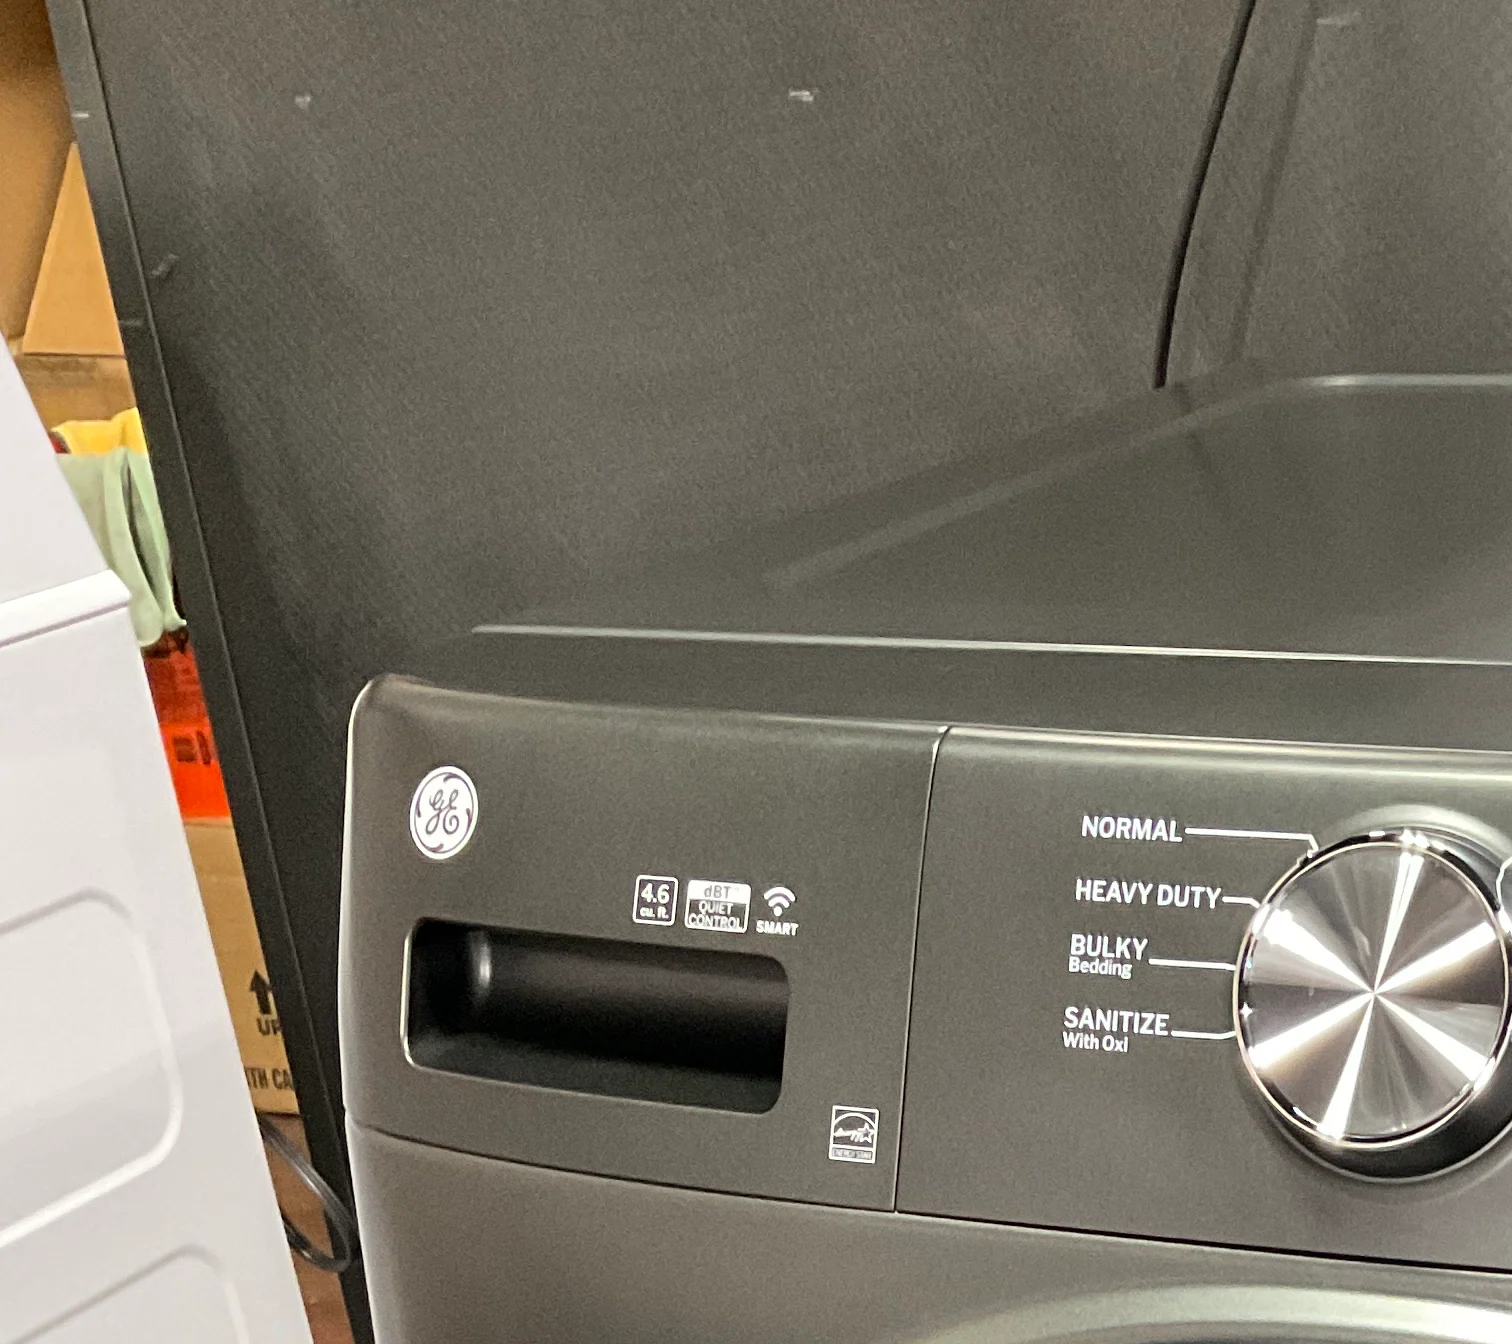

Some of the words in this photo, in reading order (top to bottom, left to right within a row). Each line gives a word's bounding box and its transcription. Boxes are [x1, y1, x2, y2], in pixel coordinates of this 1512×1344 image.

[1081, 815, 1183, 843] NORMAL
[641, 882, 670, 904] 4.6
[1075, 878, 1153, 905] HEAVY
[1156, 883, 1222, 909] DUTY
[698, 901, 734, 915] QUIET
[688, 913, 742, 930] CONTROL
[756, 920, 799, 936] SMART
[1070, 933, 1149, 961] BULKY
[1068, 956, 1133, 980] Bedding
[1063, 1006, 1170, 1036] SANITIZE
[1062, 1031, 1100, 1051] With
[1102, 1034, 1129, 1053] Oxi
